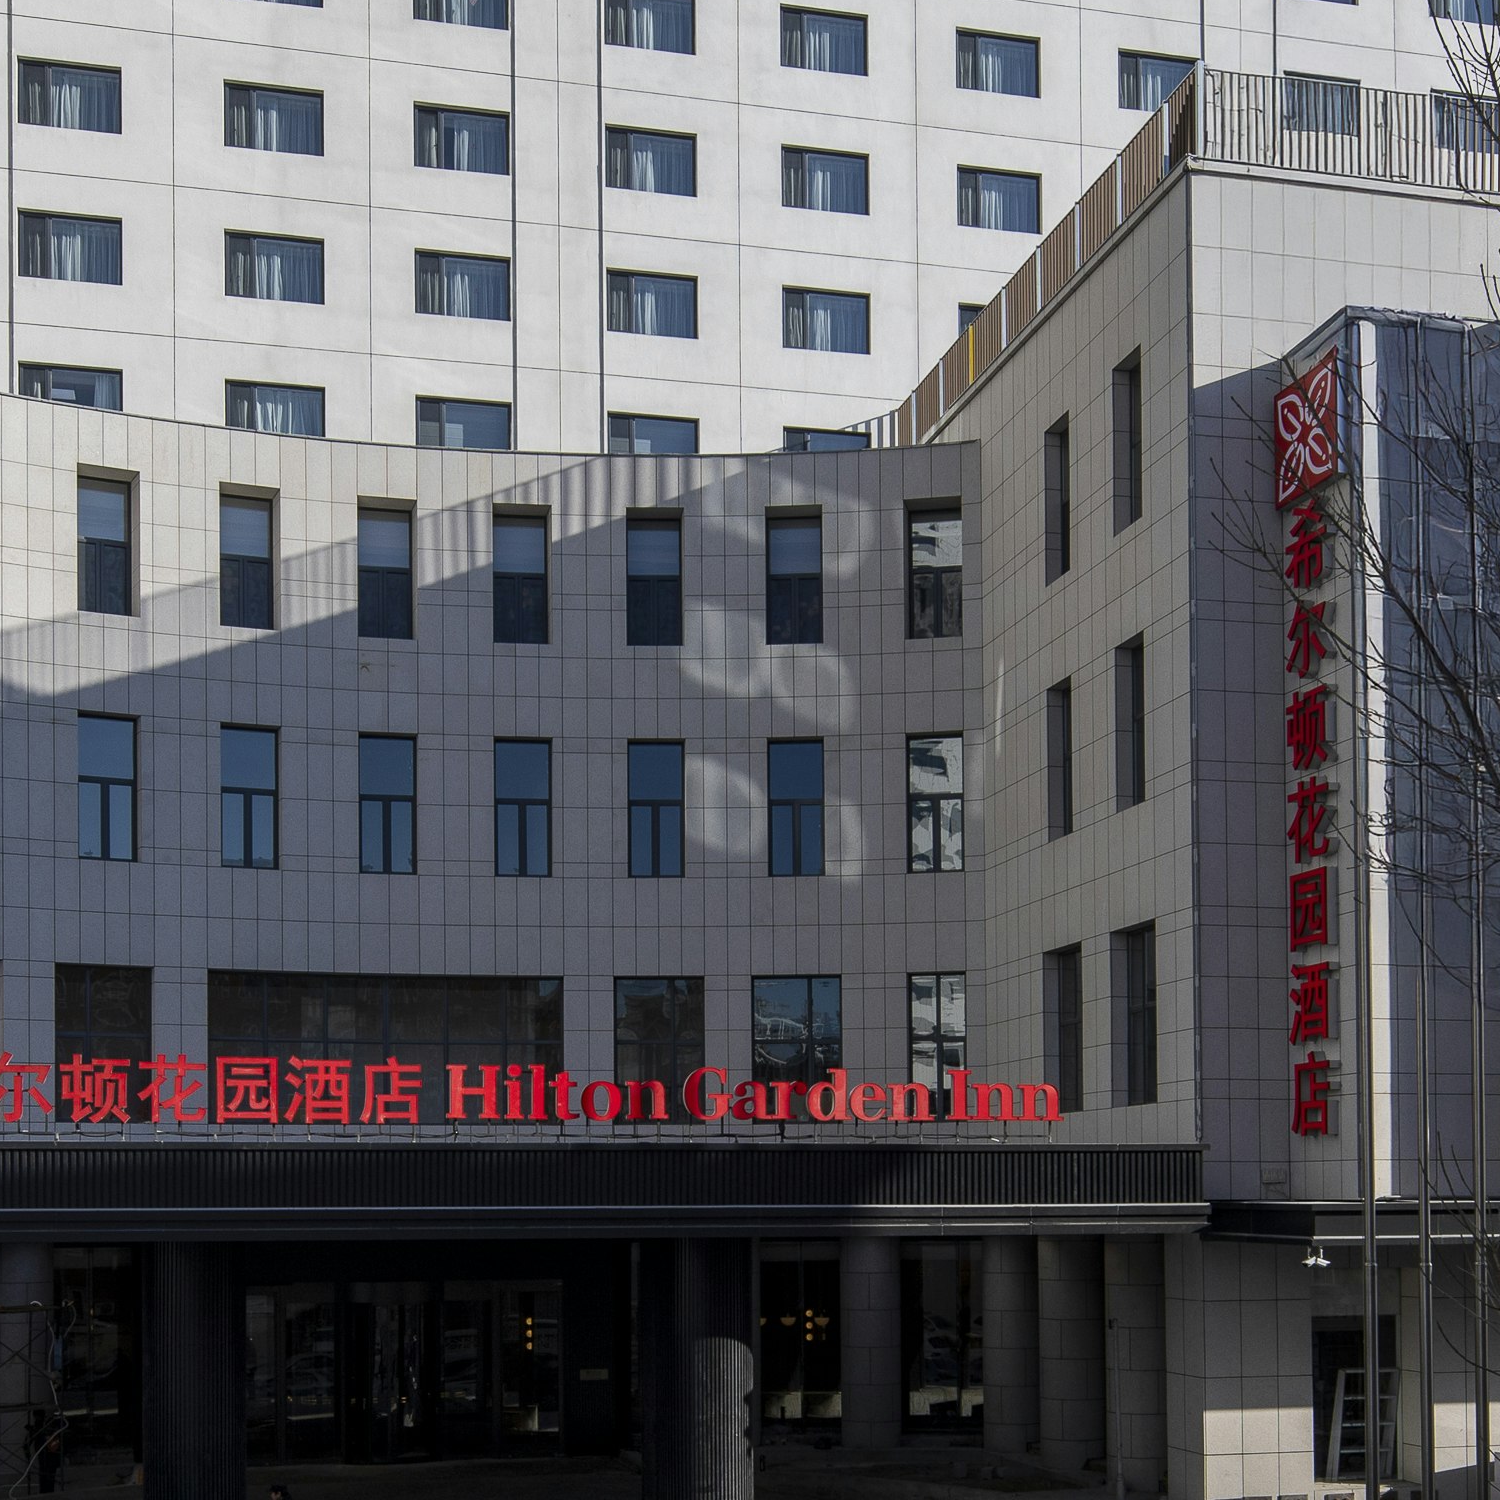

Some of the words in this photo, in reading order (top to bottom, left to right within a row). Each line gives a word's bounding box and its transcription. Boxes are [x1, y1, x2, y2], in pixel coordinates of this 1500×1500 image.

[1284, 497, 1331, 1138] 希尔顿花园酒店
[445, 1062, 670, 1122] Hilton
[683, 1065, 936, 1123] Garden
[946, 1068, 1066, 1123] Inn
